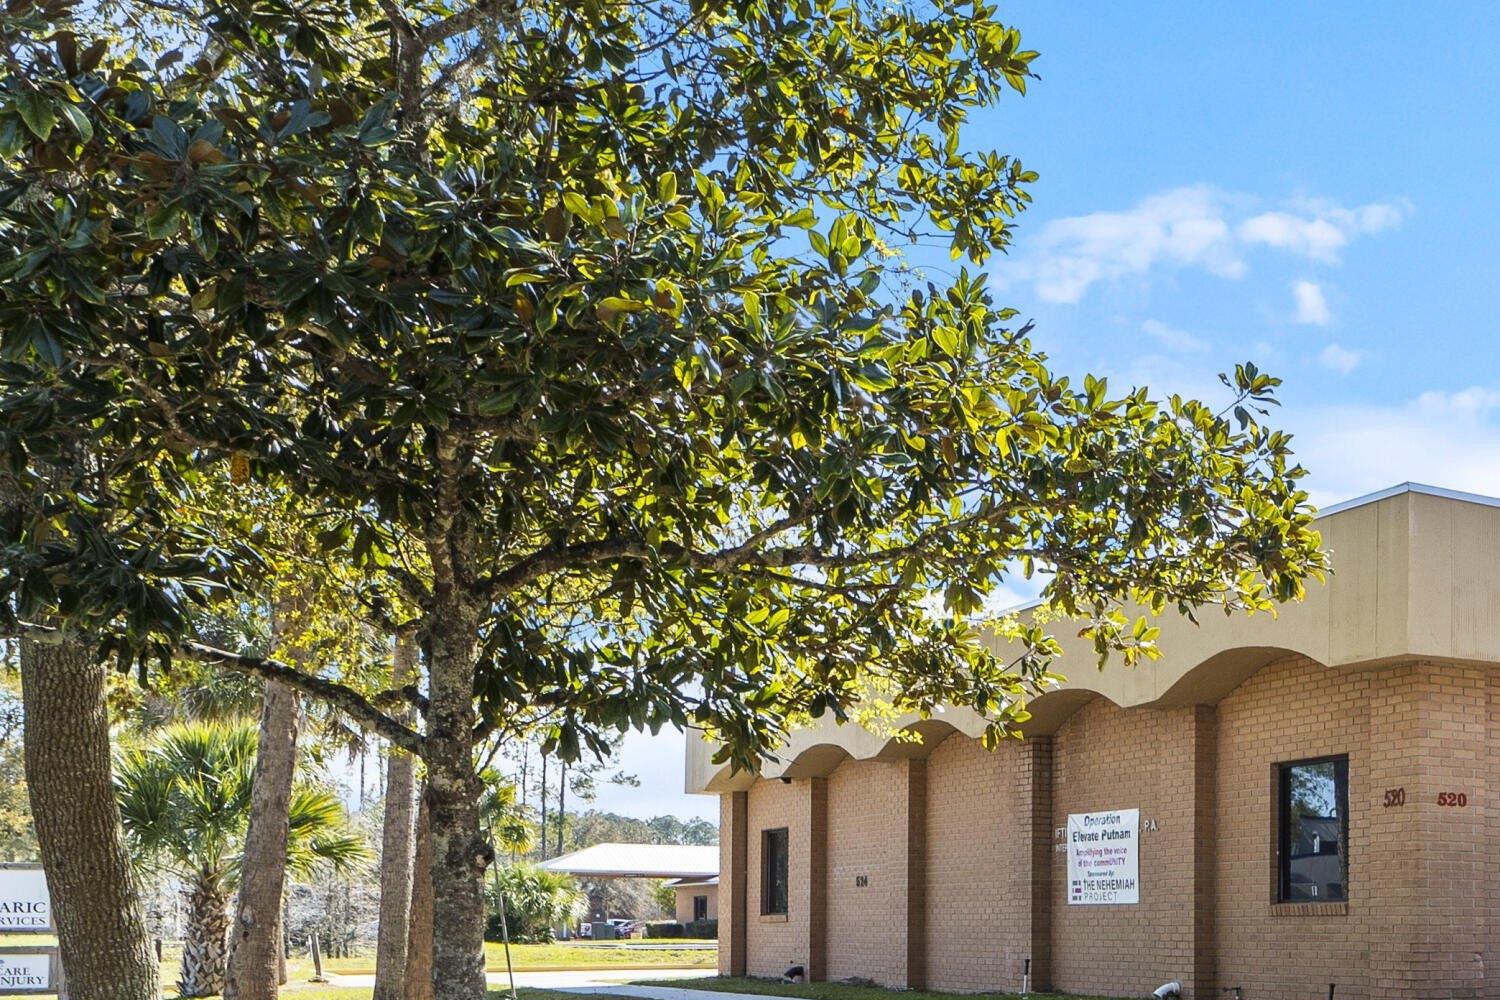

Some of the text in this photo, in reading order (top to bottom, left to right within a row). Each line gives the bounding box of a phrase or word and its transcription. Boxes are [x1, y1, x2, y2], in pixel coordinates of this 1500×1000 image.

[1384, 787, 1405, 808] 520
[1437, 792, 1467, 807] 520
[1084, 814, 1121, 828] Operation
[1073, 831, 1099, 842] Elevate
[1101, 829, 1131, 840] Putnam
[1076, 848, 1103, 857] Amplifying
[1114, 847, 1127, 855] voice
[1083, 859, 1092, 867] the
[1083, 879, 1135, 890] THE NEHEMIAH
[1084, 891, 1118, 901] PROJECT
